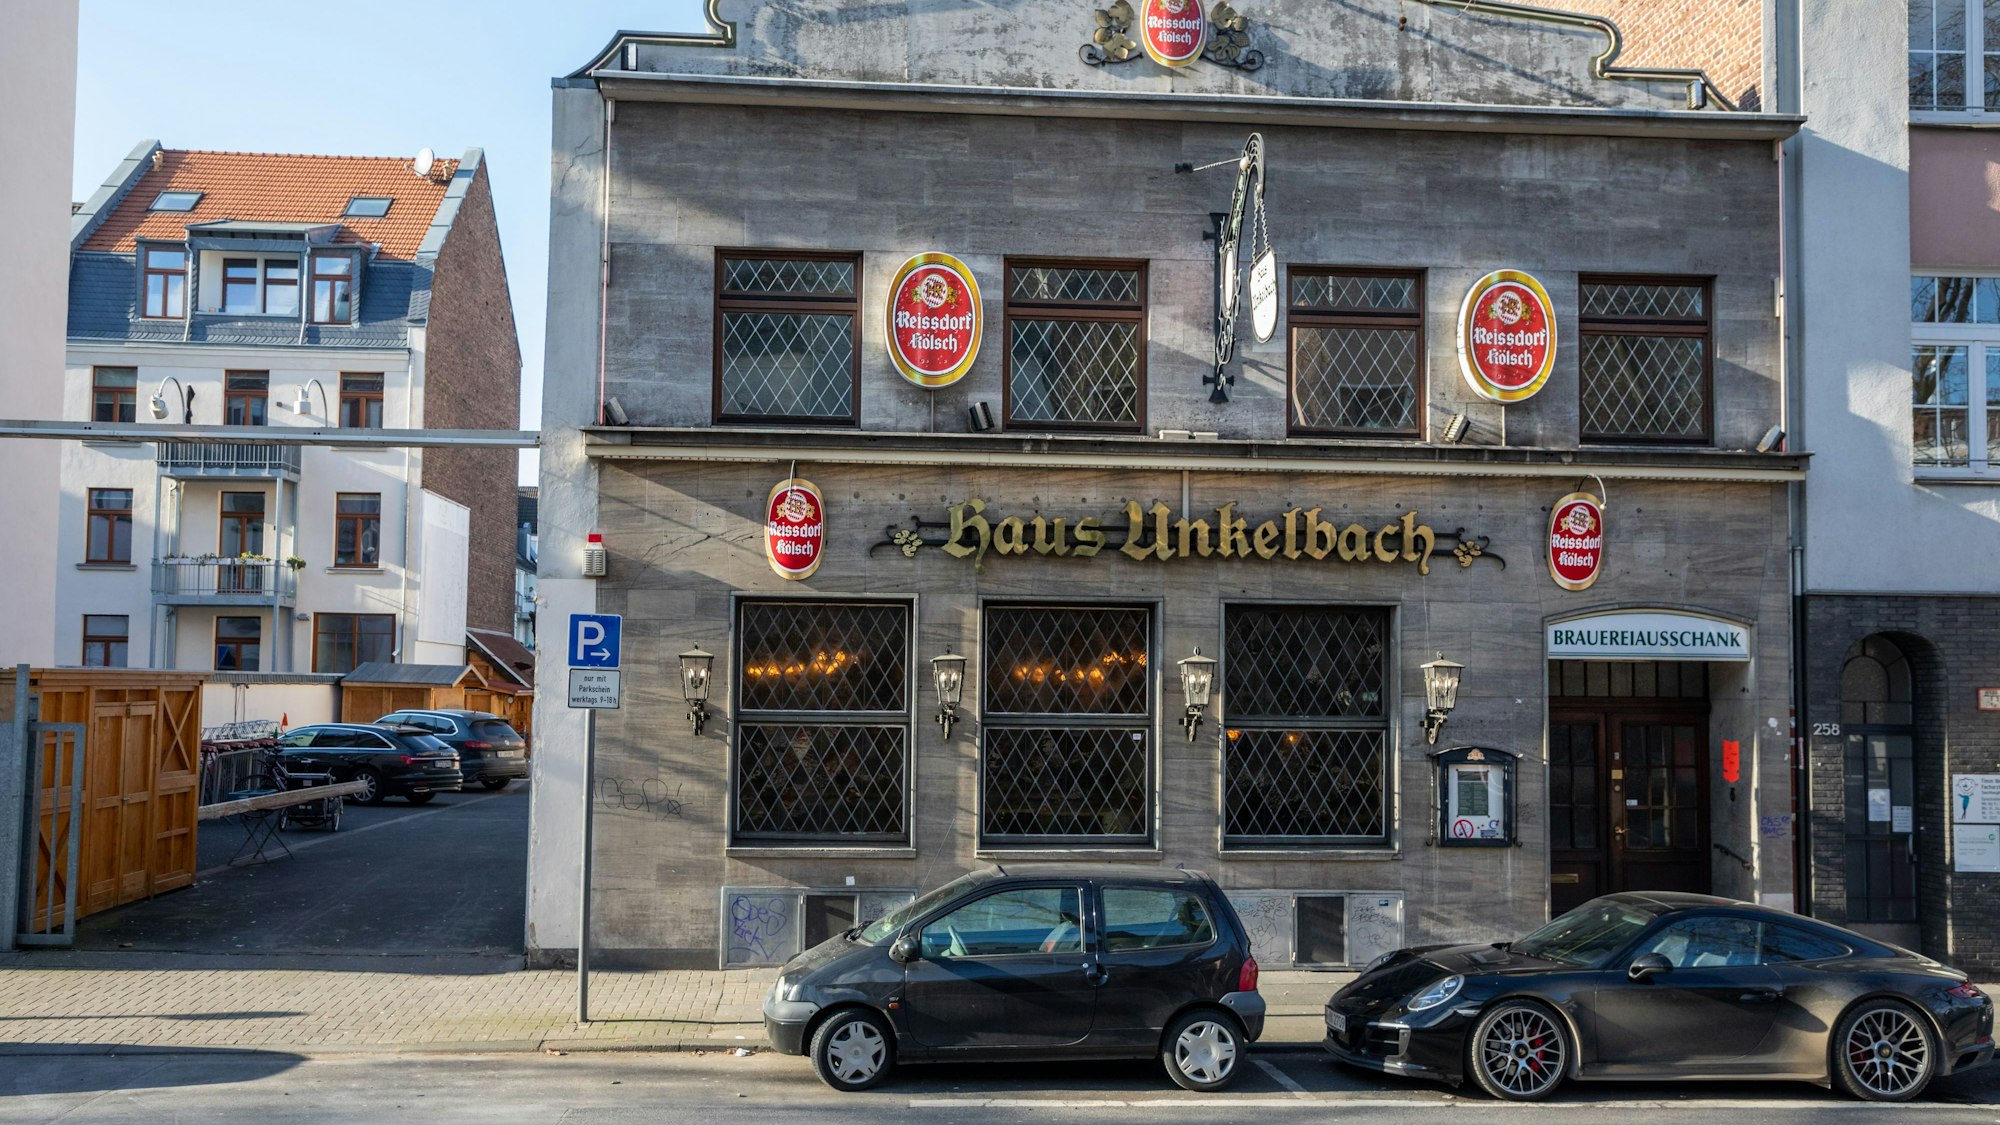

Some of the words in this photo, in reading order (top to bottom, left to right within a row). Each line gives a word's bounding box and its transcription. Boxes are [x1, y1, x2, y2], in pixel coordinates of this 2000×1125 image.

[1148, 16, 1200, 30] Reissdorf
[1158, 30, 1192, 45] Kölsch
[896, 311, 974, 330] Reissdorf
[910, 332, 957, 353] Kölsch
[1473, 327, 1547, 346] Reissdorf
[1486, 348, 1533, 369] Kölsch
[769, 521, 821, 538] Reissdorf
[940, 498, 1108, 575] Haus
[1119, 499, 1435, 576] Unkelbach
[776, 539, 813, 557] Kölsch
[1552, 533, 1601, 550] Reissdorf
[1558, 551, 1594, 568] Kölsch
[577, 620, 605, 660] P
[1553, 629, 1741, 647] BRAUEREIAUSSCHANK
[578, 685, 611, 693] Parkschein
[571, 696, 598, 704] werktags
[1813, 723, 1840, 736] 258
